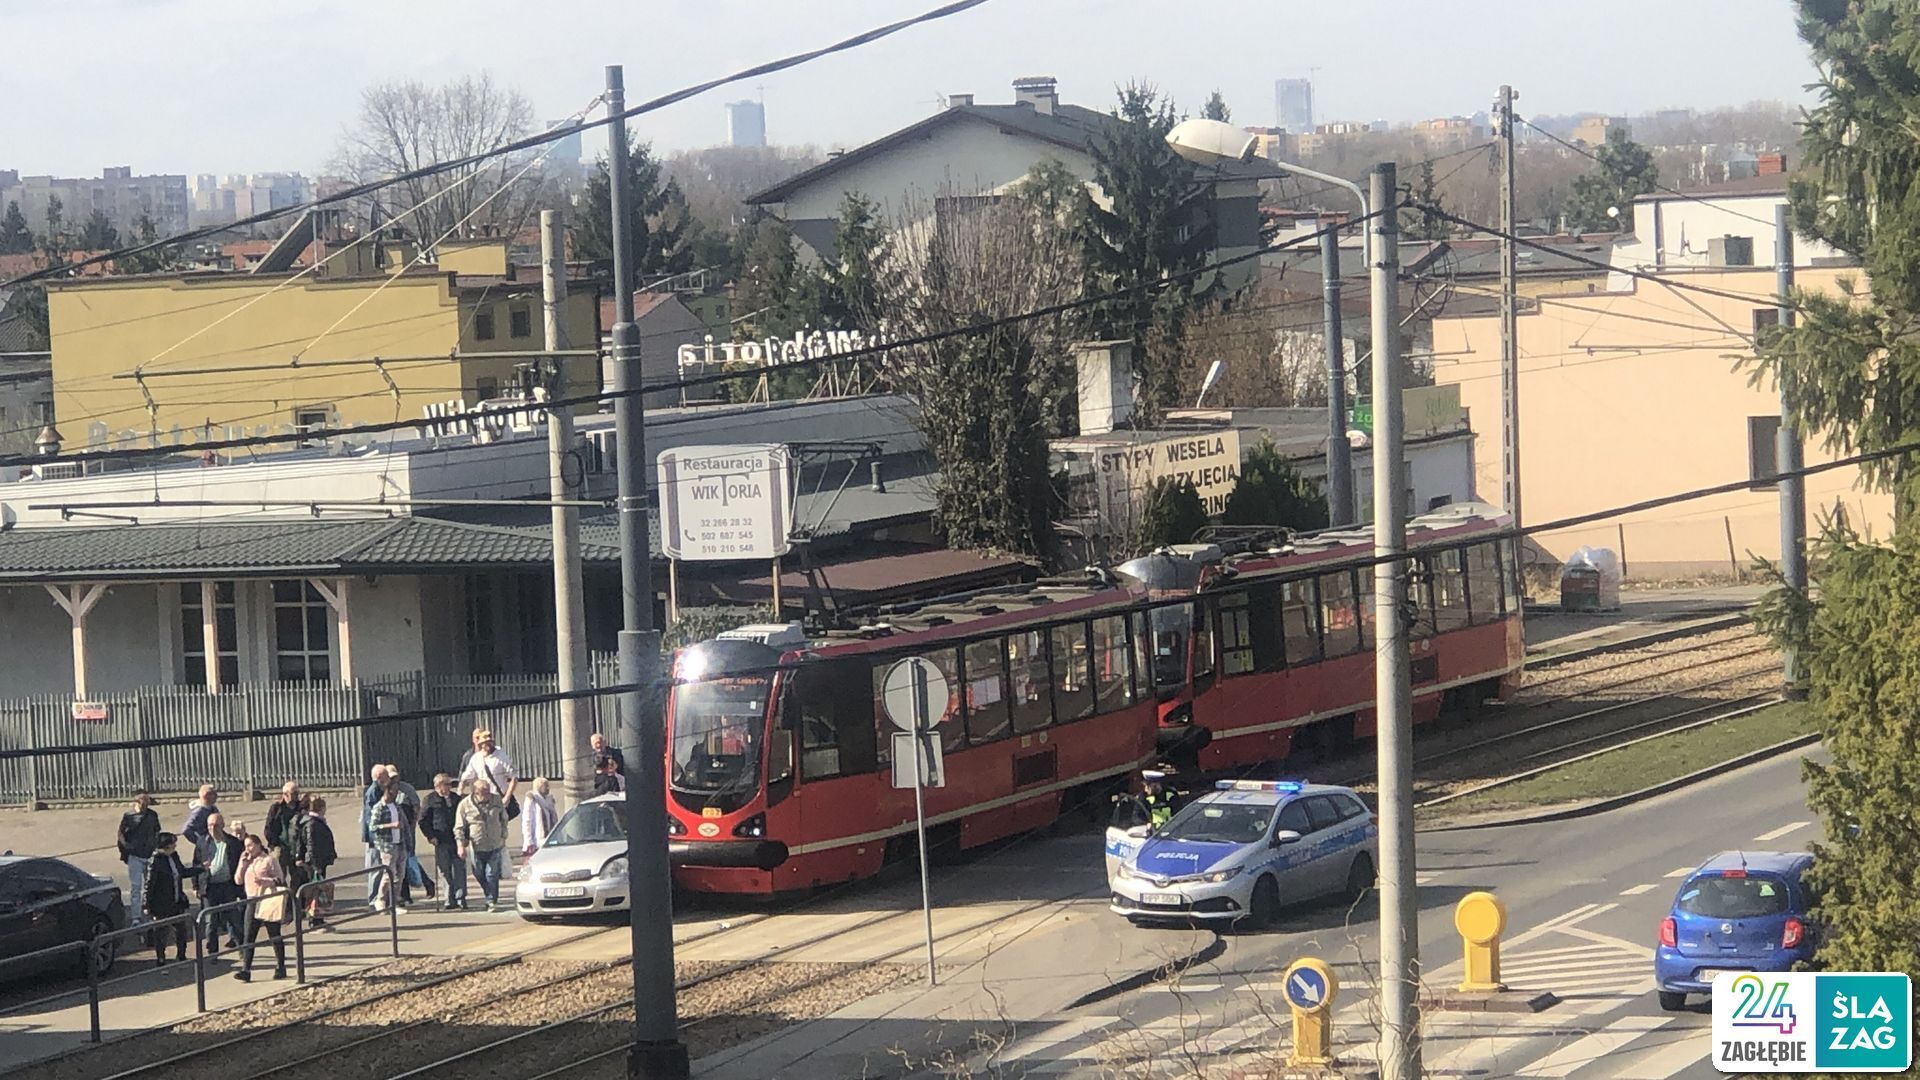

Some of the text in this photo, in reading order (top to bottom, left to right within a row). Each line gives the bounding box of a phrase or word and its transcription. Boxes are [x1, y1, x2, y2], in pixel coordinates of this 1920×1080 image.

[1166, 437, 1225, 463] WESELA
[683, 456, 763, 472] Restauracja
[691, 472, 762, 507] WIKTORIA
[720, 544, 735, 553] 210
